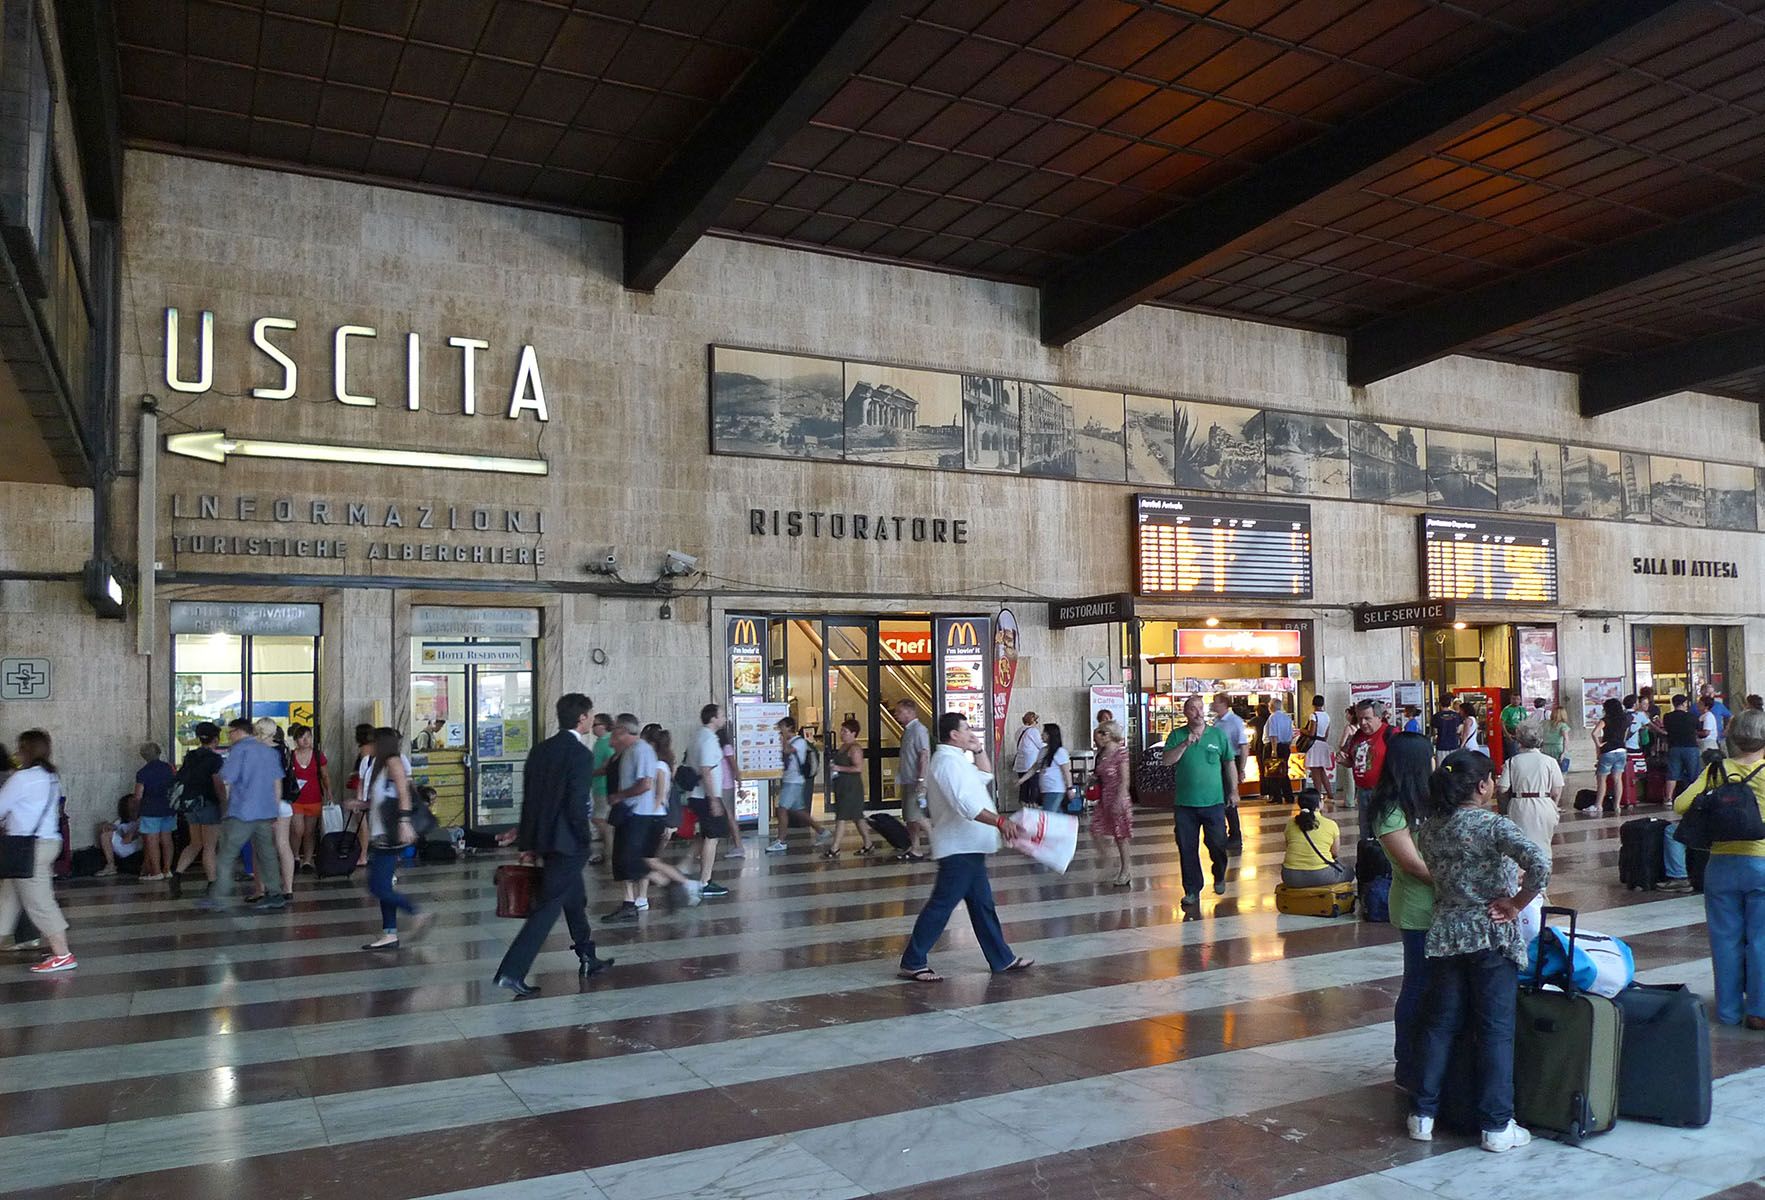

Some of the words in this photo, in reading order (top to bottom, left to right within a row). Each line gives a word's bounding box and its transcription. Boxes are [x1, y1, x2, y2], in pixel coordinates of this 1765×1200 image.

[164, 306, 549, 423] USCITA
[172, 494, 546, 534] INFORMAZIONI
[749, 508, 968, 544] RISTORATORE
[172, 534, 348, 558] TURISTICHE
[368, 542, 546, 566] ALBERGHIERE
[1632, 557, 1668, 575] SALA
[1672, 559, 1686, 576] DI
[1691, 560, 1739, 578] ATTESA
[1060, 601, 1117, 620] RISTORANTE
[1285, 623, 1308, 631] BAR
[438, 651, 464, 660] HOTEL
[467, 651, 520, 660] RESERVATION
[956, 647, 975, 655] lovin'
